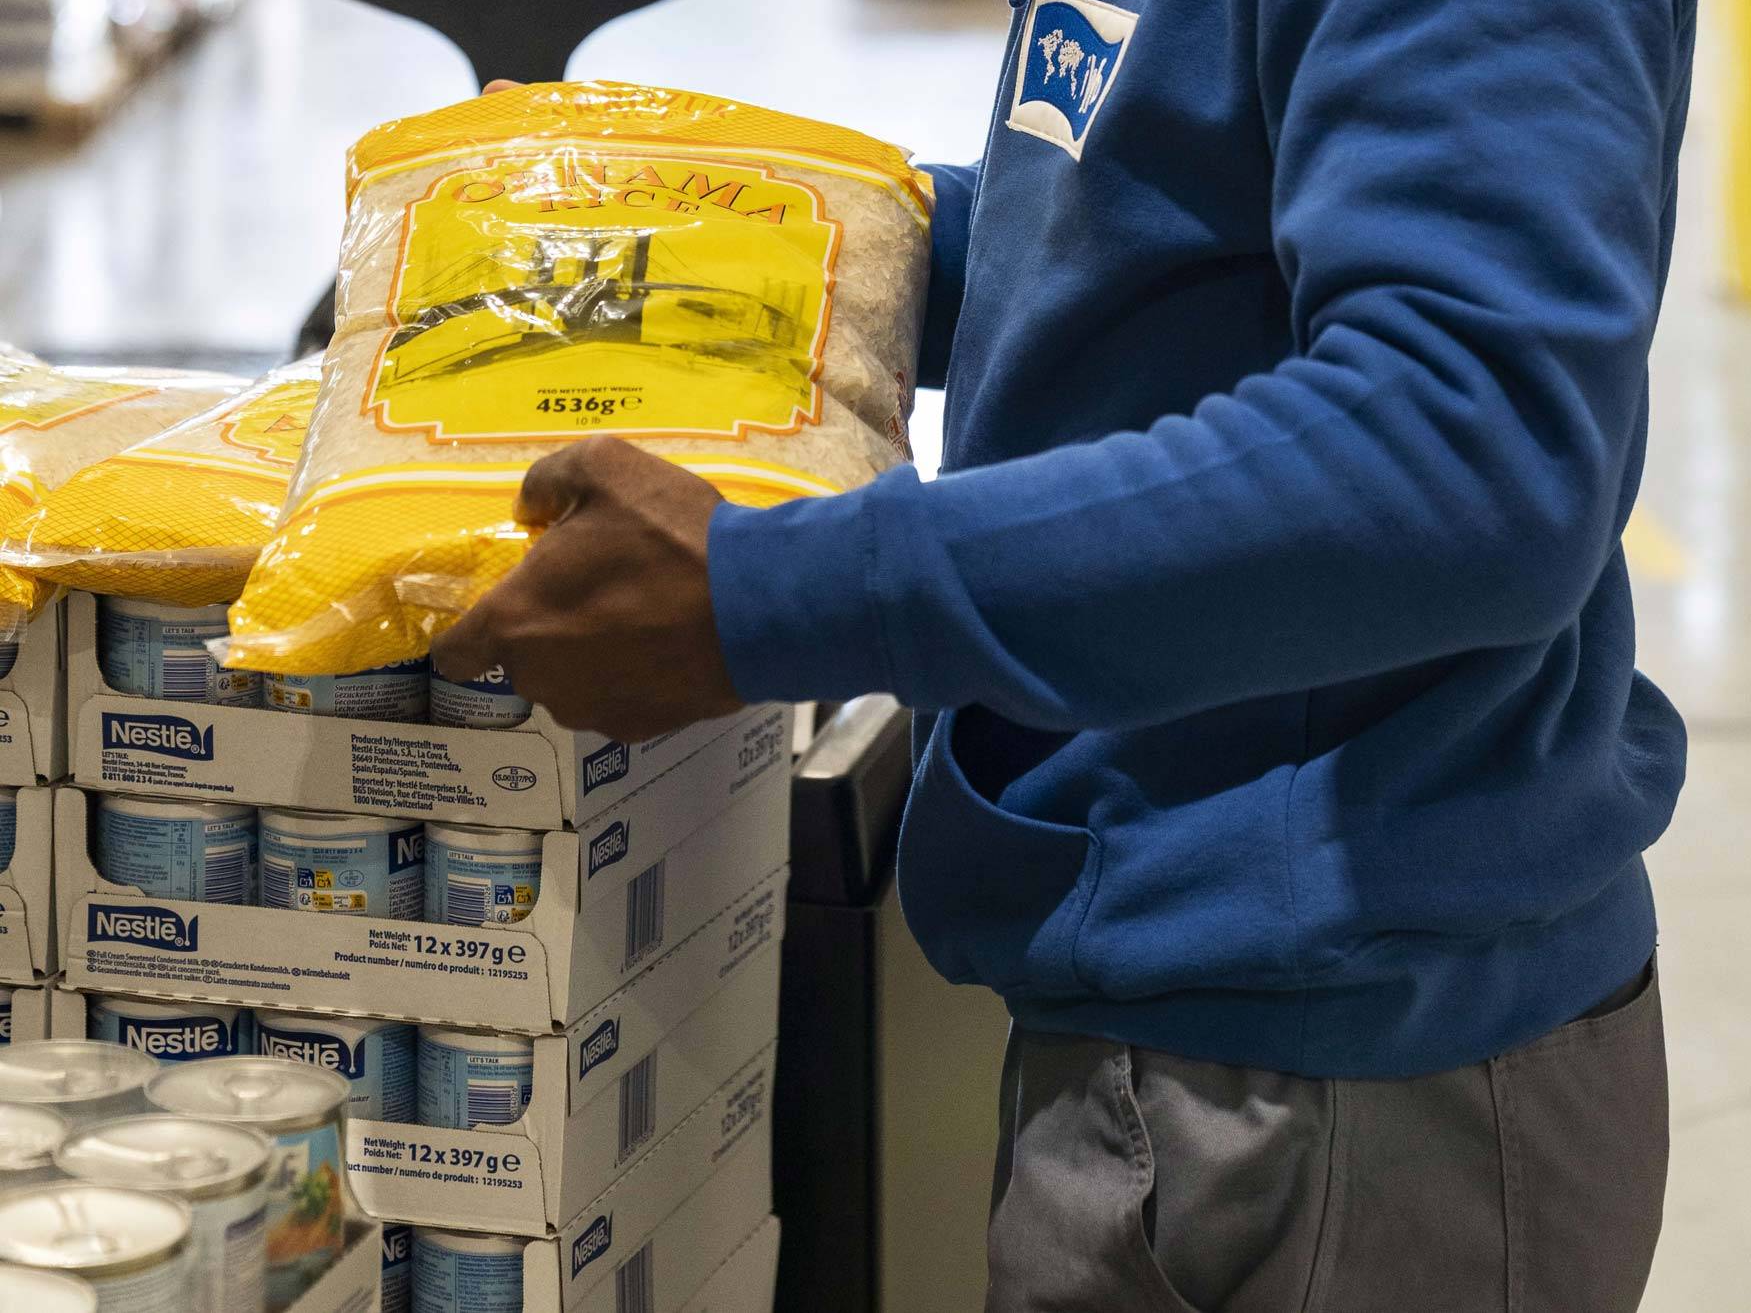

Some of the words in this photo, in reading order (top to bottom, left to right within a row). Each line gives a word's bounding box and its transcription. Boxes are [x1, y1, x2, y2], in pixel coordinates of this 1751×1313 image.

[536, 396, 616, 415] 4536g
[110, 720, 192, 749] Nestlé
[351, 734, 382, 745] Produced
[352, 754, 373, 764] 36649
[586, 748, 622, 787] Nestlé
[108, 773, 120, 781] 811
[122, 774, 135, 782] 800
[352, 776, 384, 786] Imported
[385, 778, 396, 789] by:
[418, 782, 456, 793] Enterprises
[354, 795, 370, 804] 1800
[591, 829, 622, 870] Nestlé
[96, 912, 176, 941] Nestlé
[369, 930, 384, 939] Net
[384, 931, 410, 942] Weight
[369, 940, 390, 950] Poids
[392, 942, 408, 952] Net:
[334, 952, 366, 964] Product
[368, 956, 399, 967] number
[405, 959, 437, 970] numéro
[438, 962, 448, 972] de
[488, 968, 528, 980] 12195253
[126, 1024, 219, 1054] Nestlé
[582, 1026, 612, 1072] Nestlé
[364, 1137, 378, 1147] Net
[378, 1138, 405, 1150] Weight
[364, 1148, 385, 1158] Poids
[386, 1150, 402, 1160] Net:
[362, 1164, 394, 1174] number
[400, 1168, 430, 1179] numéro
[432, 1171, 442, 1180] de
[482, 1176, 522, 1188] 12195253
